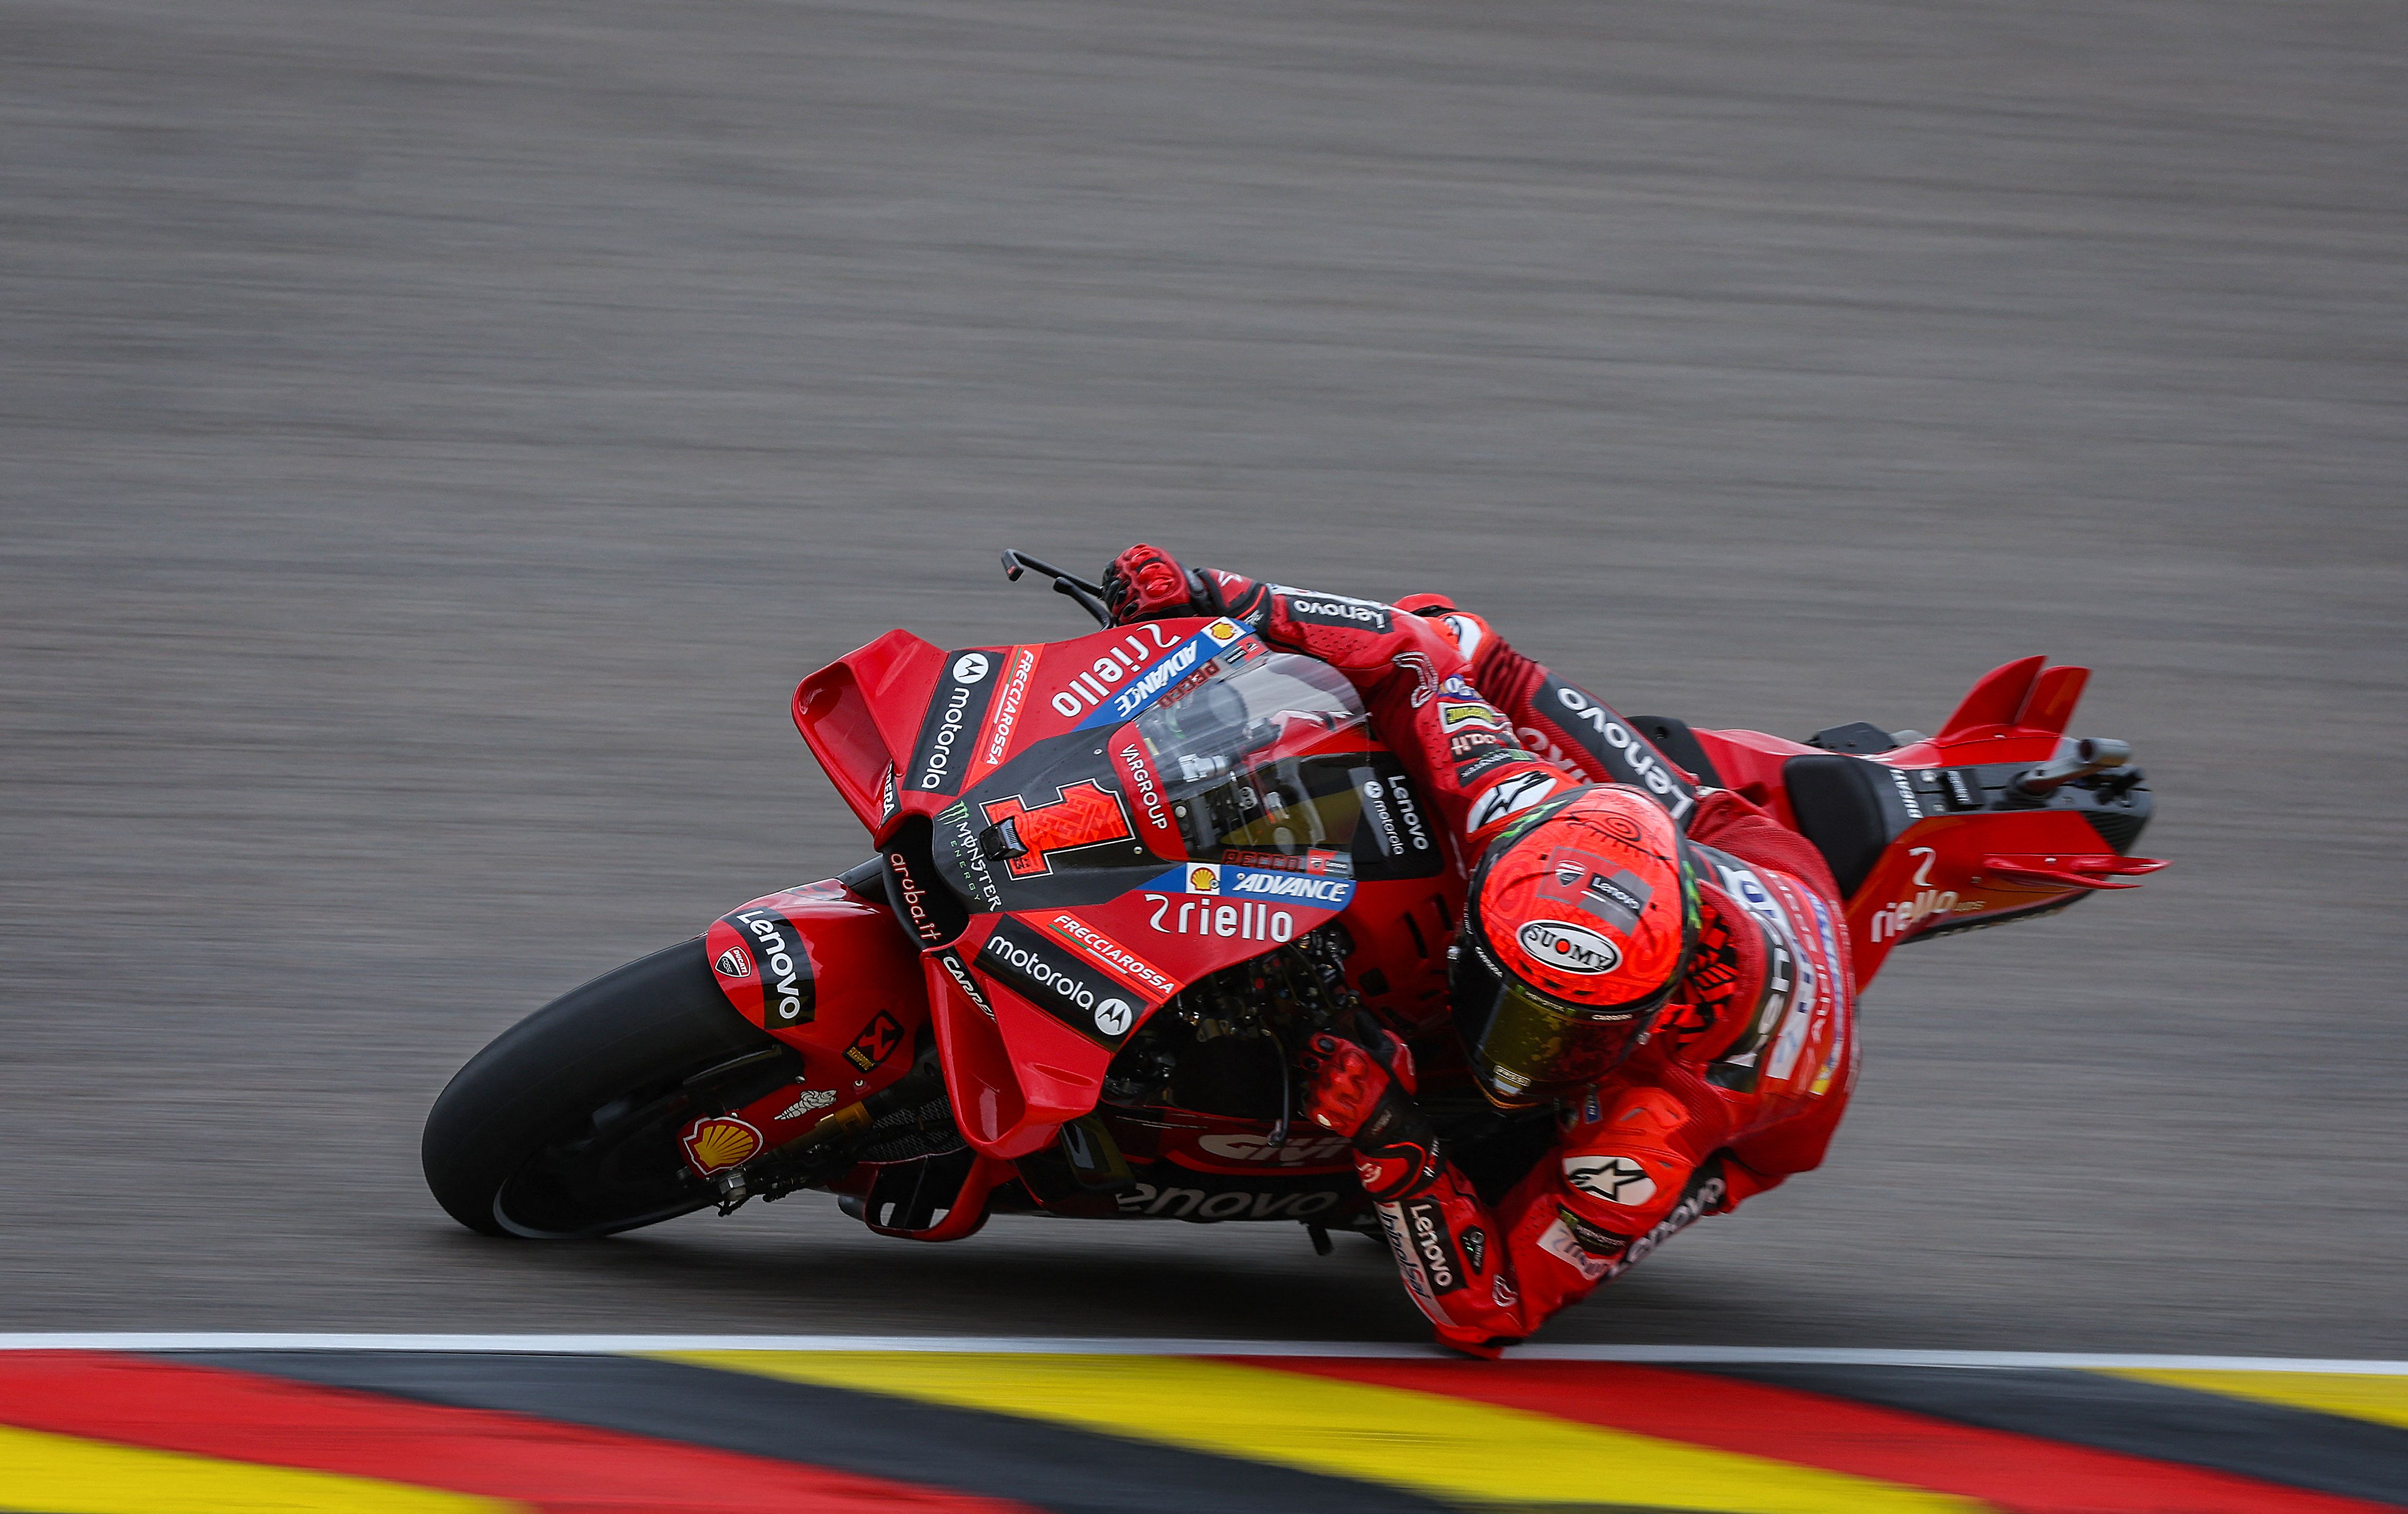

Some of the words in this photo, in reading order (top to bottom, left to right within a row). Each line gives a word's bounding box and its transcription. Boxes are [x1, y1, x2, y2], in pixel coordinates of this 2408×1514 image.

[1293, 600, 1386, 629] Lenovo
[986, 649, 1034, 766] FRECCIAROSSA
[1114, 640, 1198, 717] ADVANCE
[921, 687, 970, 789] motorola
[1557, 688, 1694, 821] Lenovo
[1120, 743, 1168, 831] VARGROUP
[1388, 775, 1429, 851] Lenovo
[979, 778, 1135, 881] 1
[1373, 800, 1405, 855] motorola
[891, 854, 942, 941] aruba.it
[950, 840, 981, 901] ENERGY
[956, 822, 1002, 912] MONSTER
[1232, 873, 1348, 903] ADVANCE
[1592, 876, 1641, 911] Lenovo
[733, 949, 748, 973] DUCATI
[735, 910, 801, 1019] Lenovo
[987, 935, 1095, 1011] motorola
[1052, 914, 1178, 995] FRECCIAROSSA
[1529, 924, 1612, 971] SUOMY
[1115, 1183, 1339, 1218] enovo
[1409, 1204, 1453, 1287] Lenovo
